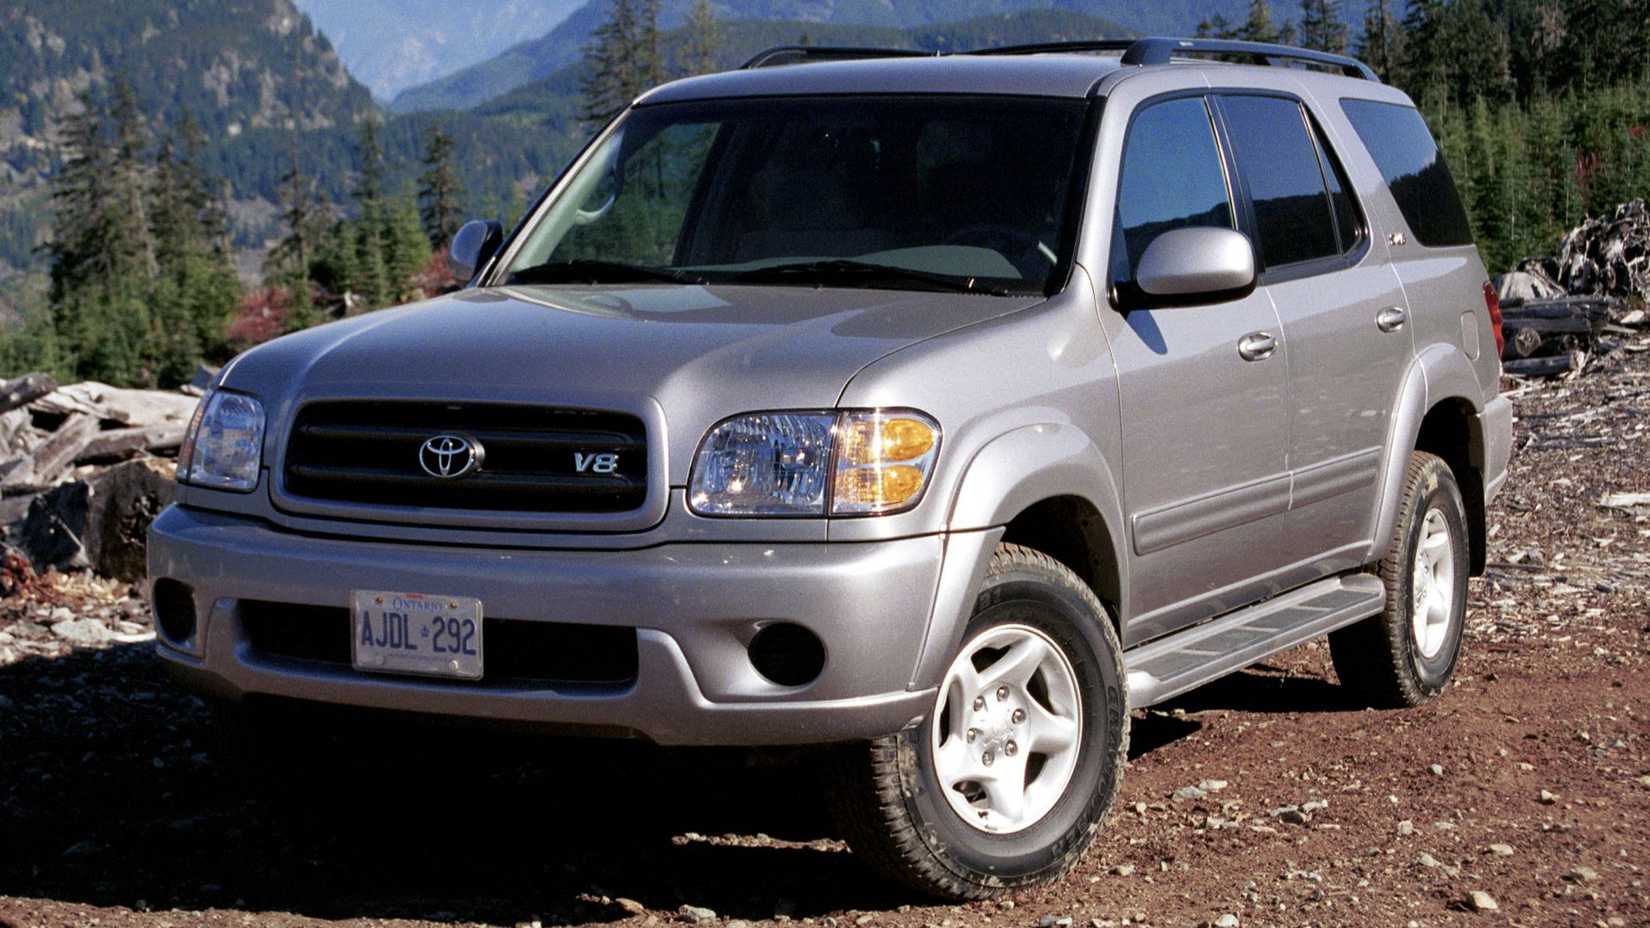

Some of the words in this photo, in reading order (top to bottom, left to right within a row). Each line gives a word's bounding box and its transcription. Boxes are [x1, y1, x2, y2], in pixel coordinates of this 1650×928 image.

[574, 452, 618, 473] V8
[361, 610, 417, 650] AJDL
[432, 615, 476, 656] 292
